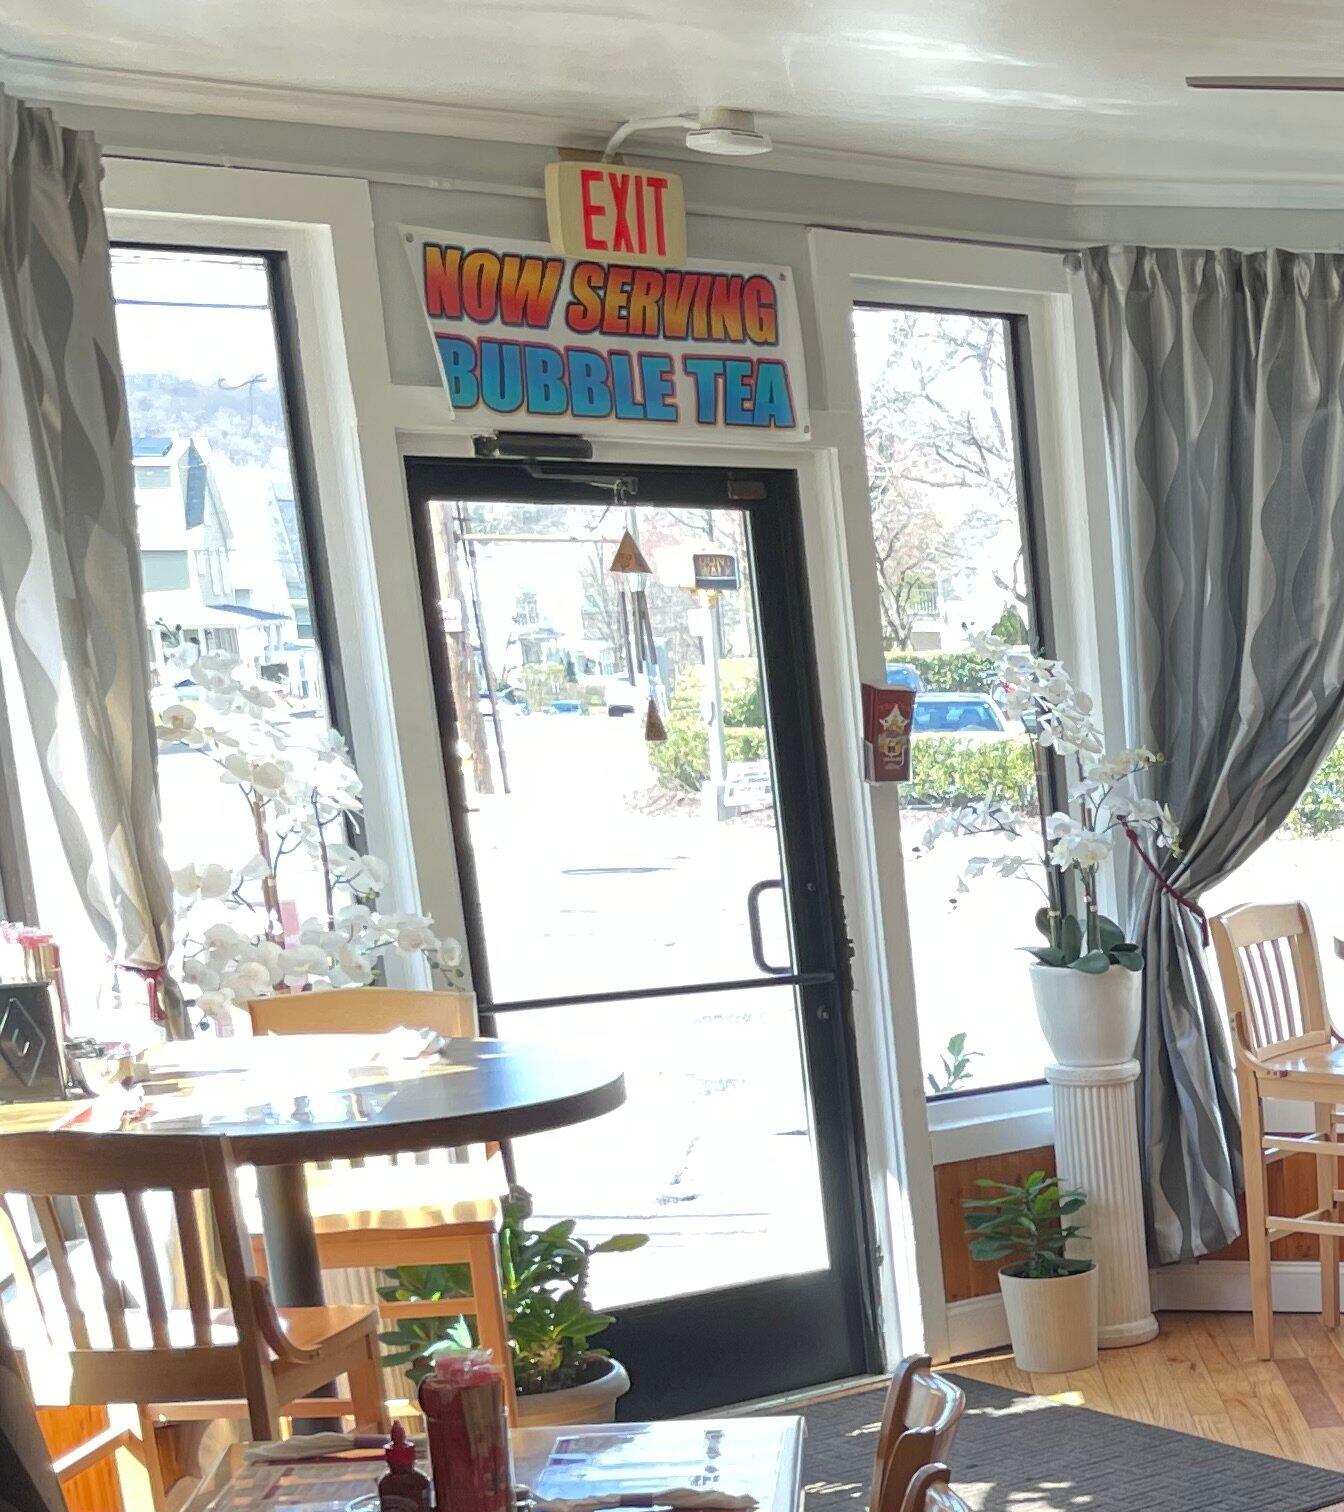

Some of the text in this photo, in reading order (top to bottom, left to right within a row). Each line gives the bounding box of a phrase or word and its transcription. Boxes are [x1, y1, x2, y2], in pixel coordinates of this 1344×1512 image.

[579, 169, 669, 257] EXIT
[422, 242, 780, 346] NOW SERVING
[435, 332, 796, 428] BUBBLE TEA
